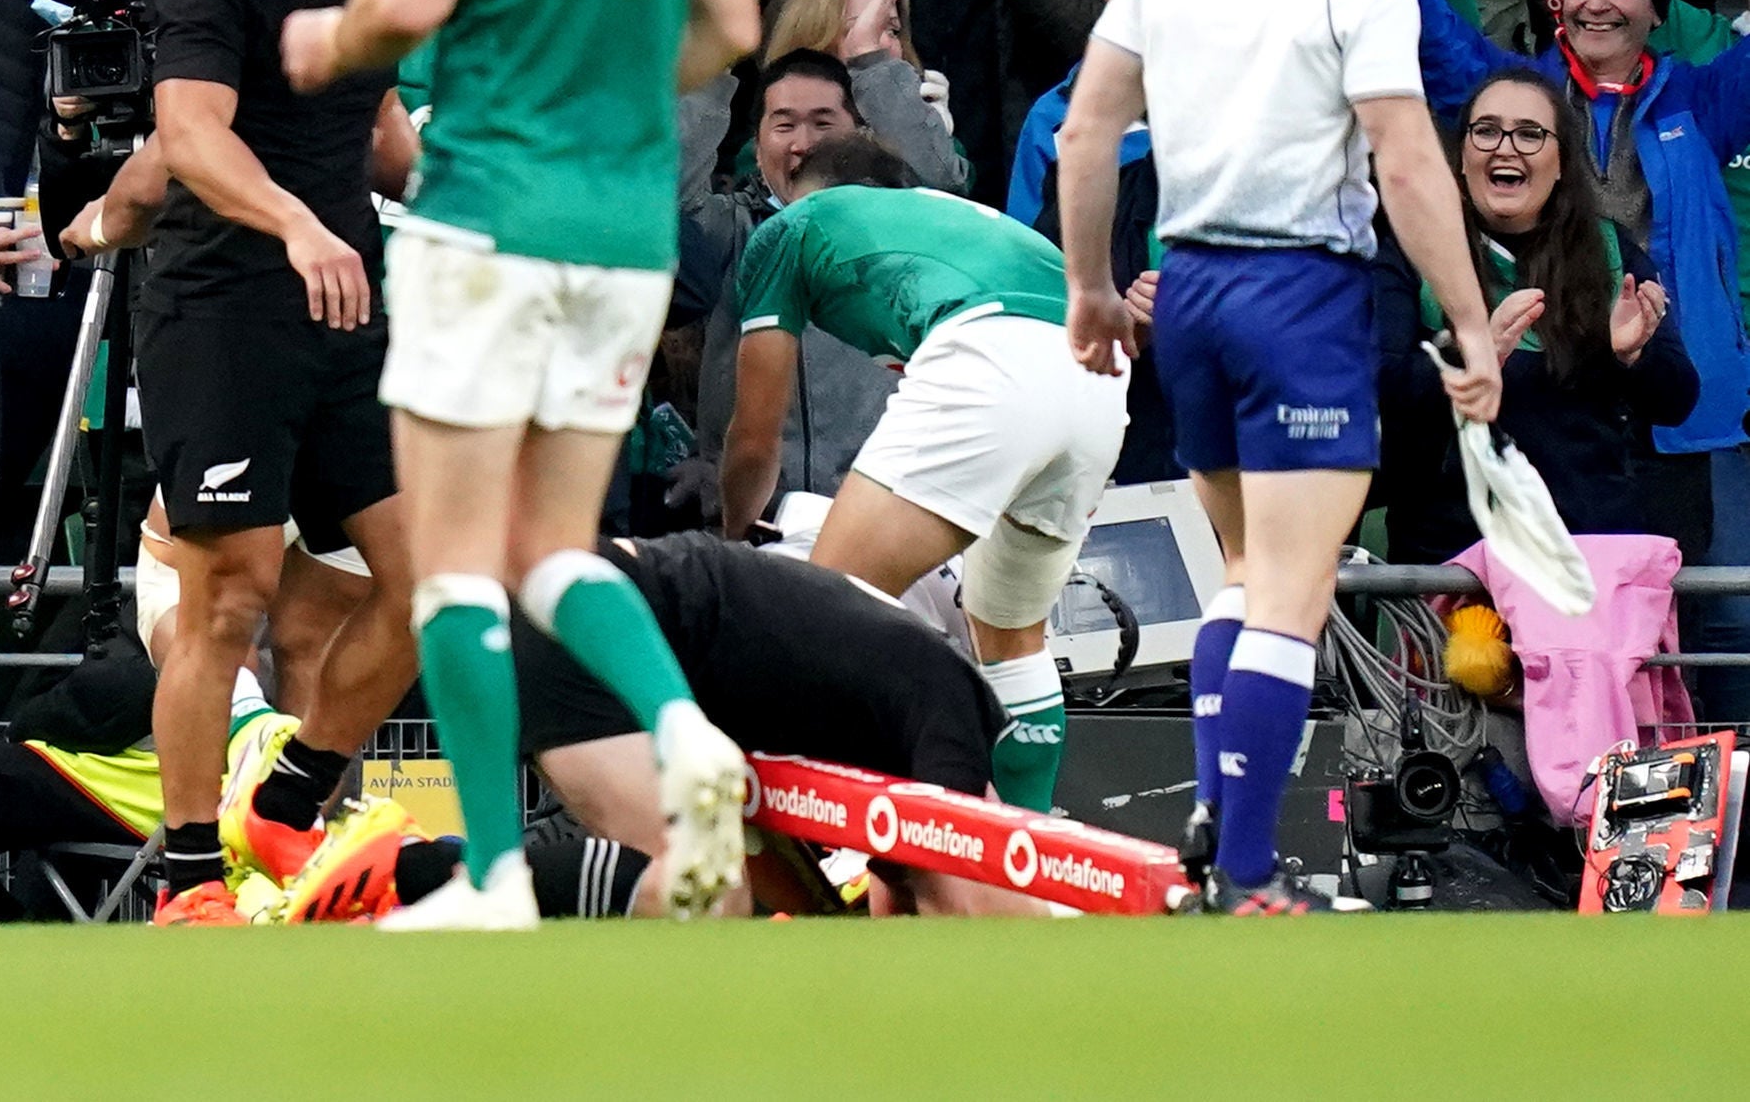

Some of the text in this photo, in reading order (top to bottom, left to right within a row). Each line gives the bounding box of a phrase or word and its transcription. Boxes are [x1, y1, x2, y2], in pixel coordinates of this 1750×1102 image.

[764, 785, 848, 829] vodafone
[901, 817, 985, 863] vodafone
[1039, 852, 1126, 899] vodafone
